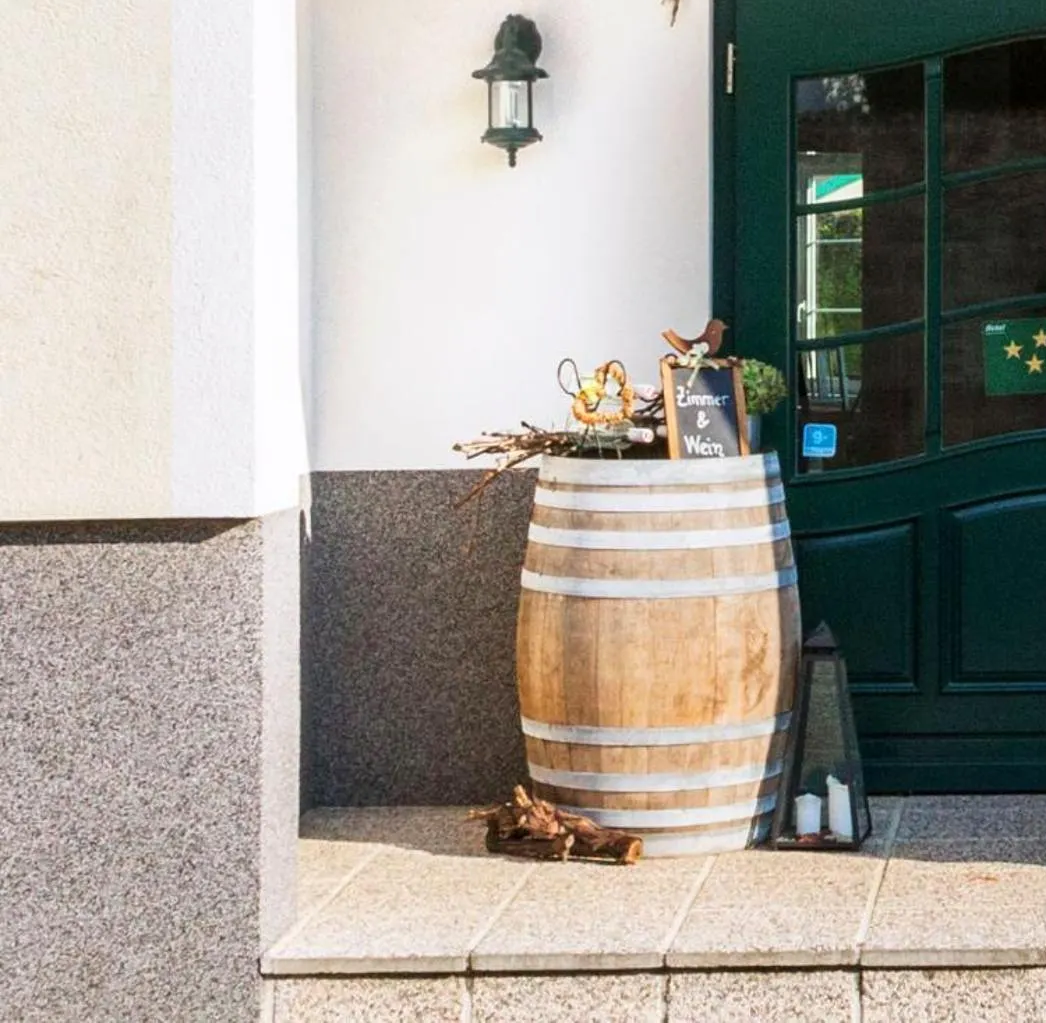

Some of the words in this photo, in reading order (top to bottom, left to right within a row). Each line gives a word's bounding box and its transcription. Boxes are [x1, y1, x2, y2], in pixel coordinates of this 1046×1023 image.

[675, 384, 730, 408] Zimmer
[696, 409, 711, 429] &
[683, 435, 726, 458] Wein
